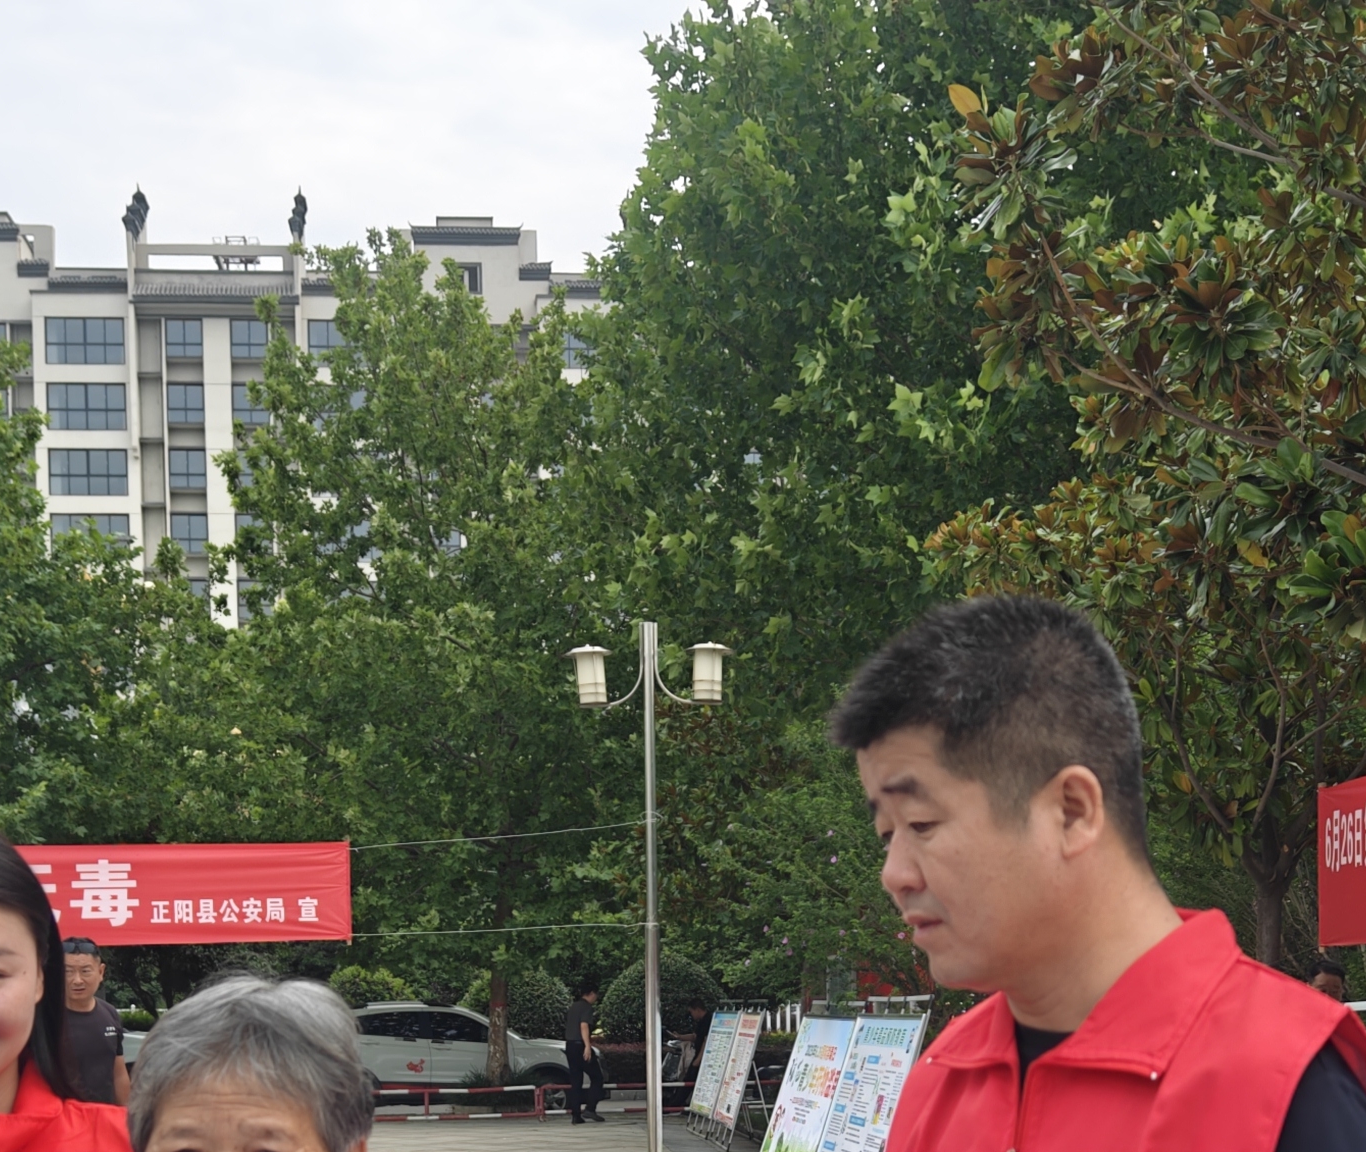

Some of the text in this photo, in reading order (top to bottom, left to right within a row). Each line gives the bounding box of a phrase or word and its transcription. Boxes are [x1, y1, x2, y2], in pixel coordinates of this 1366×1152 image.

[150, 897, 286, 925] 正阳县公安局
[297, 895, 320, 923] 宣
